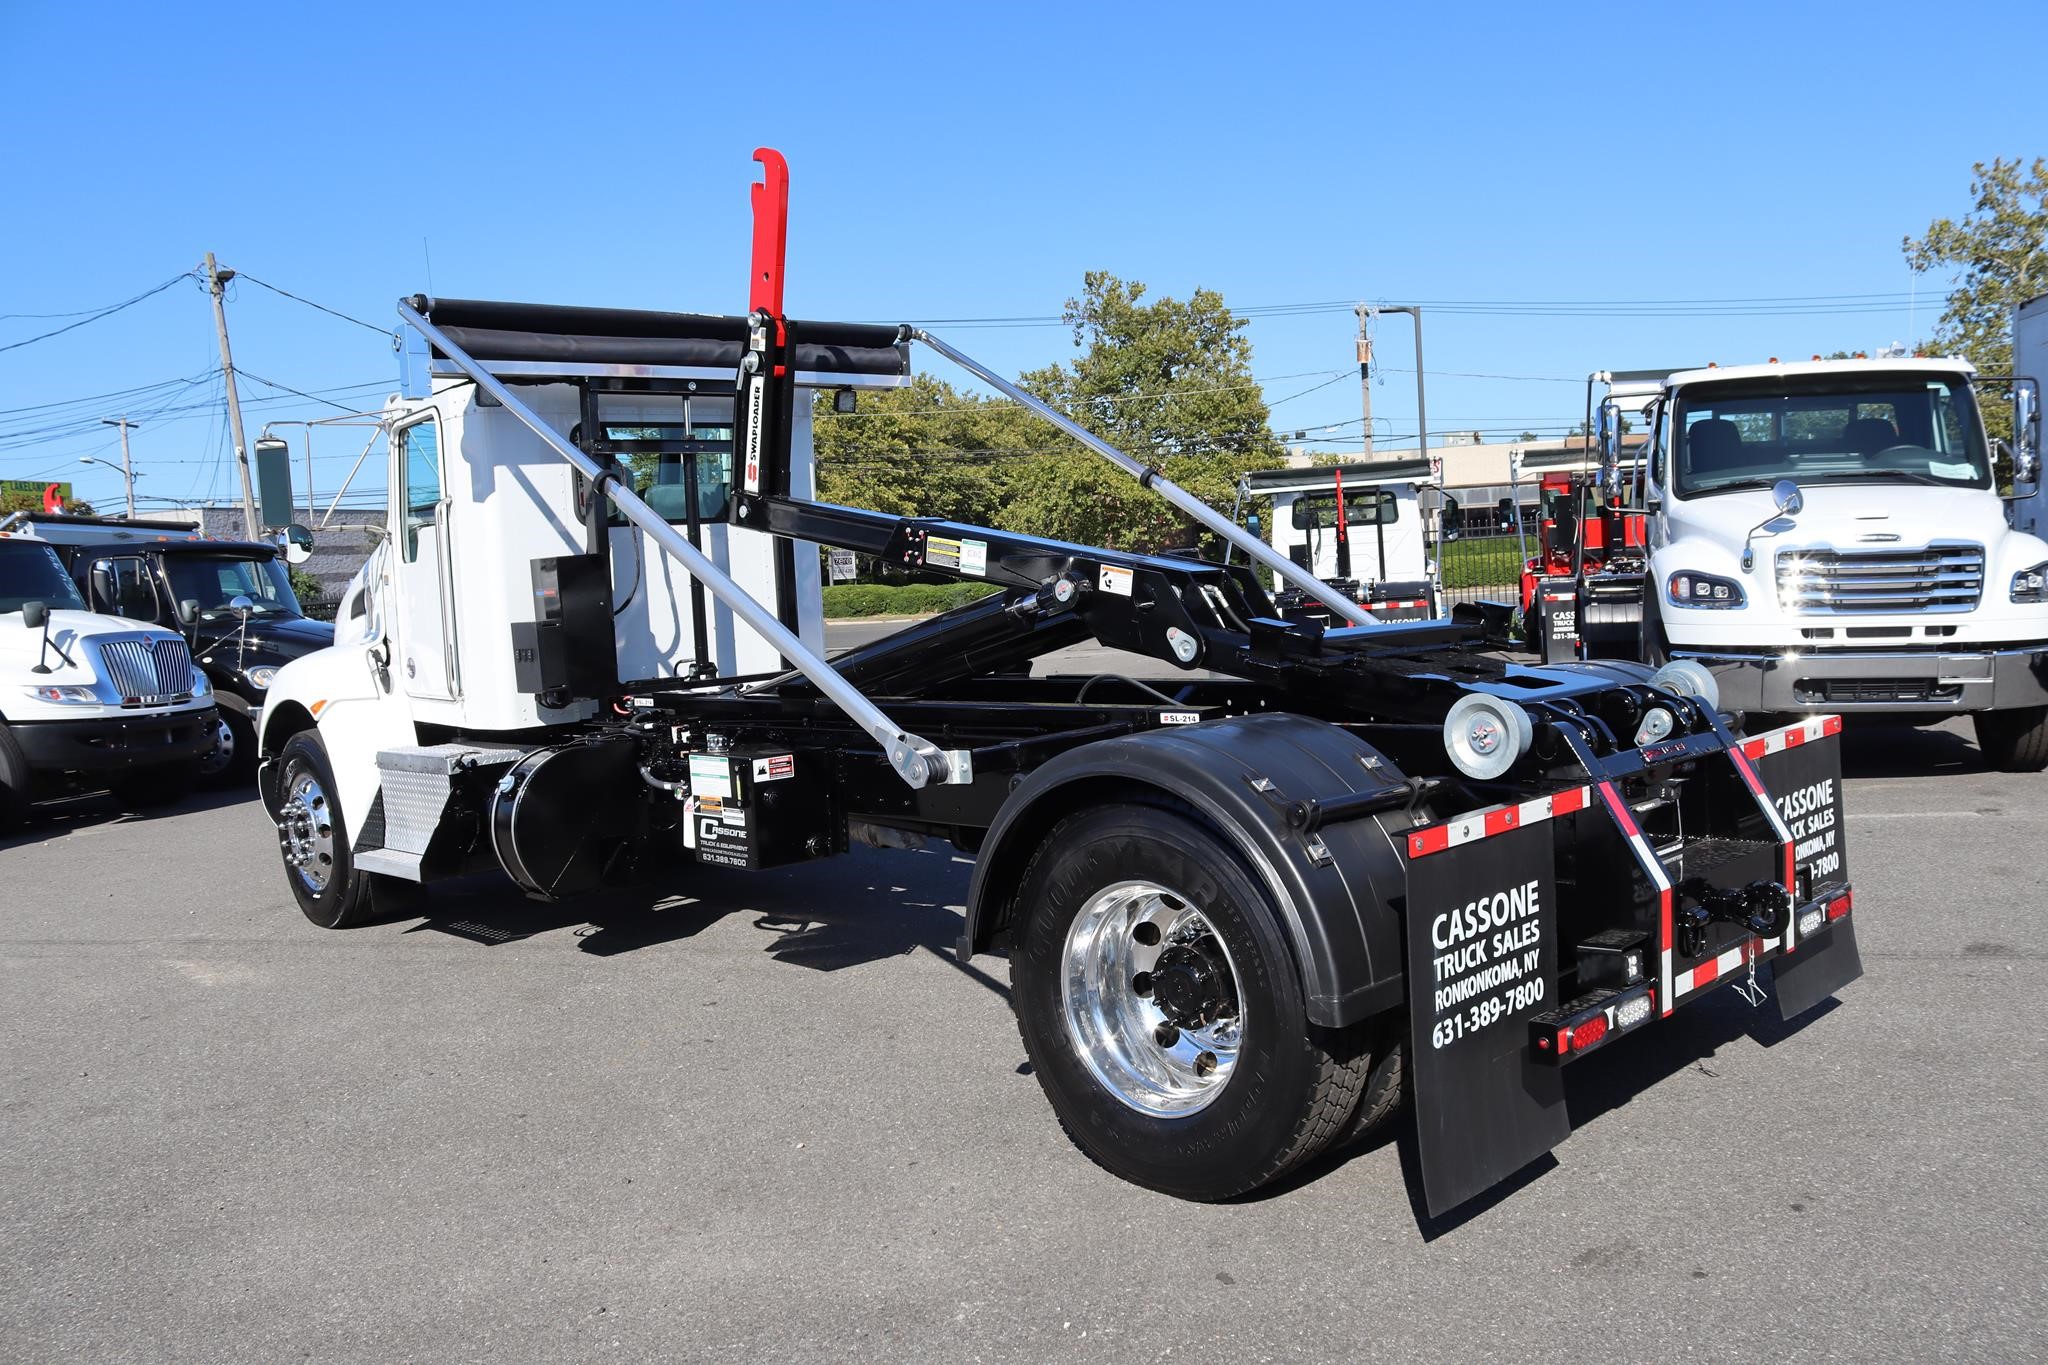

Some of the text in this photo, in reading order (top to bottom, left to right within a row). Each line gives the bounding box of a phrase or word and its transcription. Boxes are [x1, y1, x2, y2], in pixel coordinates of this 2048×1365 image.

[750, 385, 762, 461] SWAPLOADER
[700, 818, 747, 840] CASSONE
[1807, 808, 1835, 834] SALES
[1826, 830, 1835, 848] NY
[702, 853, 746, 867] 631.389.7800
[720, 842, 749, 852] EQUIPMENT
[1432, 880, 1540, 950] CASSONE
[1433, 919, 1540, 982] TRUCK SALES
[1434, 948, 1540, 1012] RONKONKOMA, NY
[1432, 977, 1544, 1050] 631-389-7800
